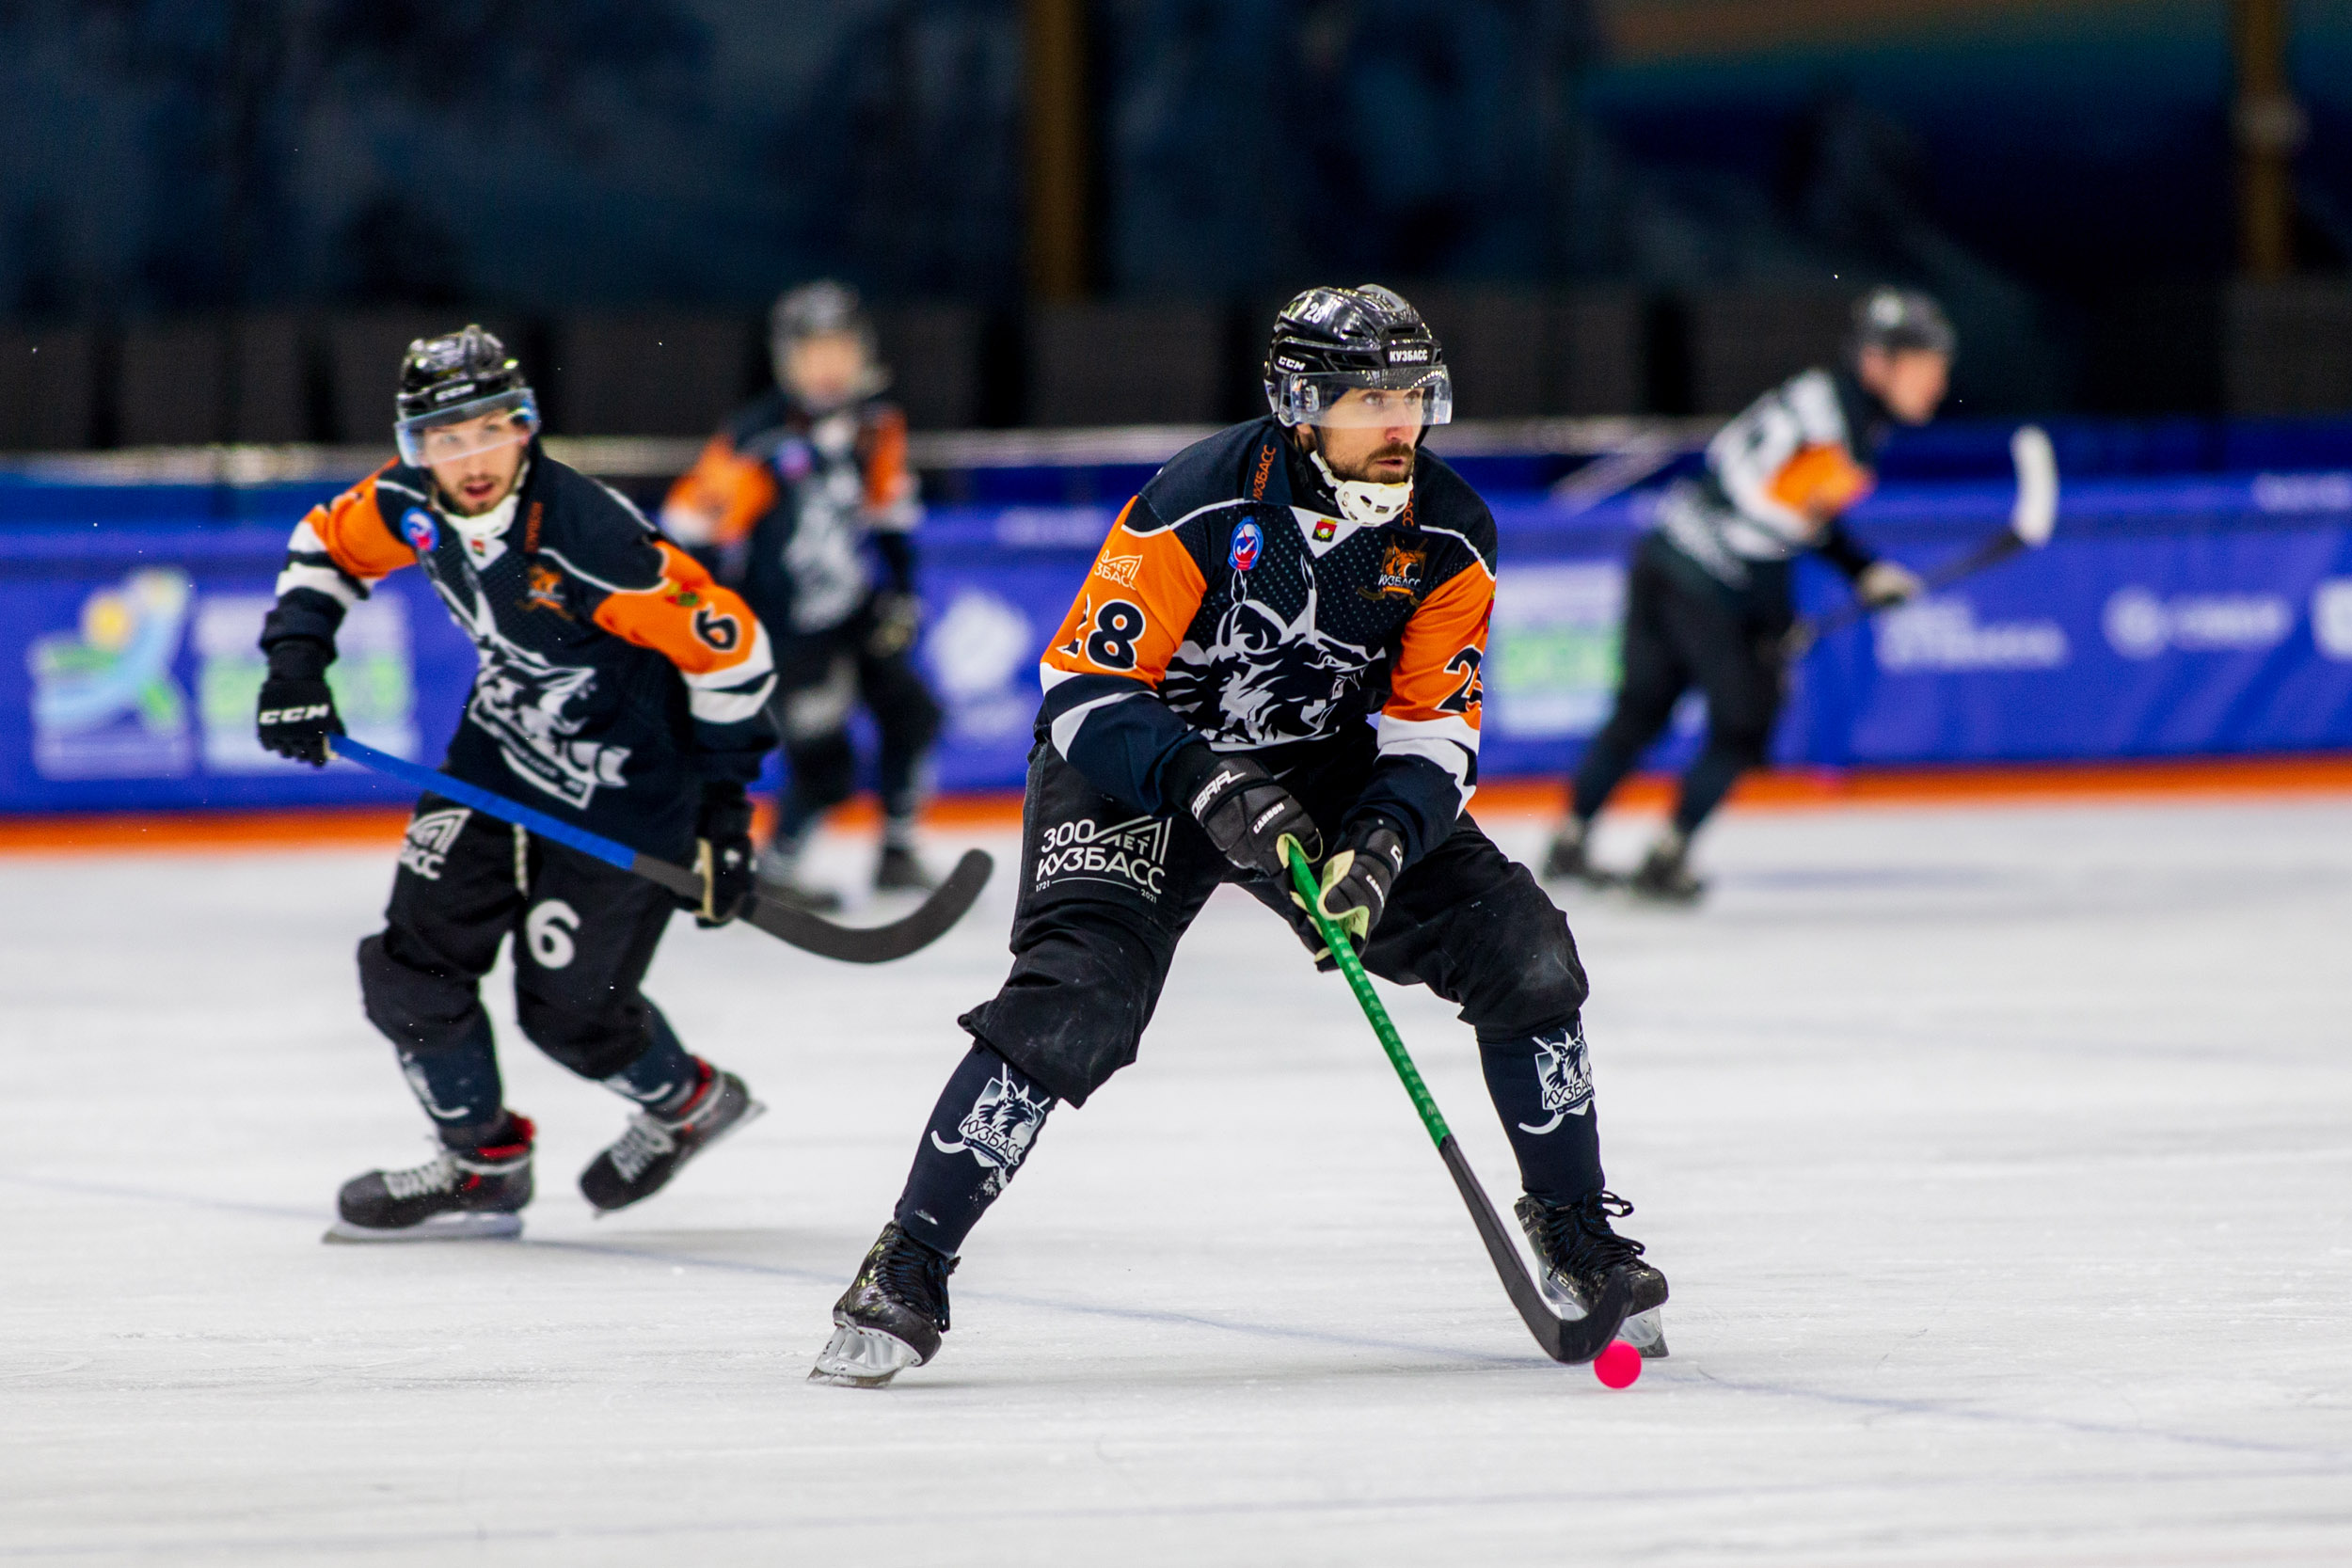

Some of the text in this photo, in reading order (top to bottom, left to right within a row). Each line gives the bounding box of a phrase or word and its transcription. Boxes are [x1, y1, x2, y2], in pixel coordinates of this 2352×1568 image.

[1278, 356, 1306, 371] CCM
[1390, 349, 1428, 362] КУЗБАСС
[691, 602, 740, 653] 6
[259, 704, 330, 725] CCM
[1041, 818, 1151, 856] 300 ЛЕТ
[1036, 847, 1167, 895] КУЗБАСС
[1036, 879, 1157, 903] 1721 2021
[526, 898, 580, 969] 6
[1544, 1070, 1593, 1109] КУЗБАС
[960, 1116, 1024, 1164] КУЗБАСС
